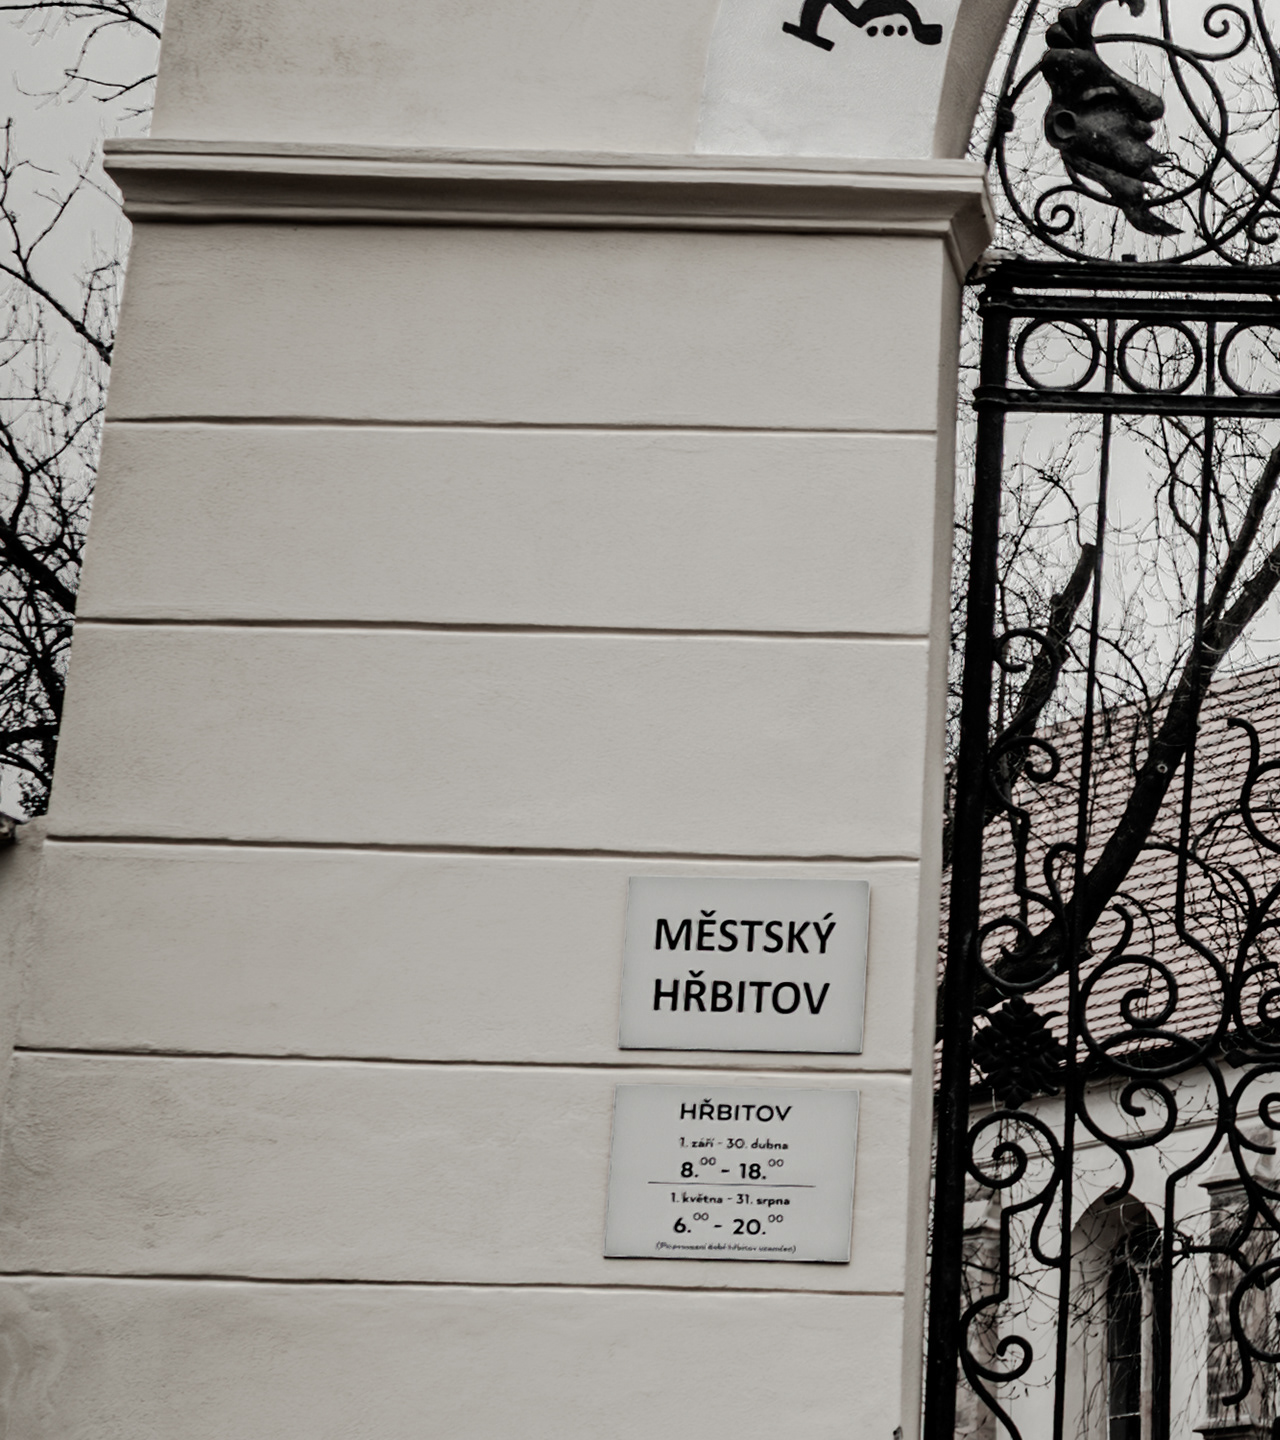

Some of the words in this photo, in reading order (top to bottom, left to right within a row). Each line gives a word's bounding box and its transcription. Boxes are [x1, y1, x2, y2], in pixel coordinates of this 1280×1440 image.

[654, 909, 837, 954] MĚSTSKÝ
[653, 969, 831, 1015] HŘBITOV
[679, 1098, 793, 1123] HŘBITOV
[692, 1137, 715, 1149] září
[726, 1138, 748, 1150] 30.
[751, 1138, 789, 1151] dubna
[671, 1192, 680, 1203] 1.
[682, 1191, 724, 1204] května
[736, 1193, 753, 1205] 31.
[756, 1198, 791, 1208] srpna
